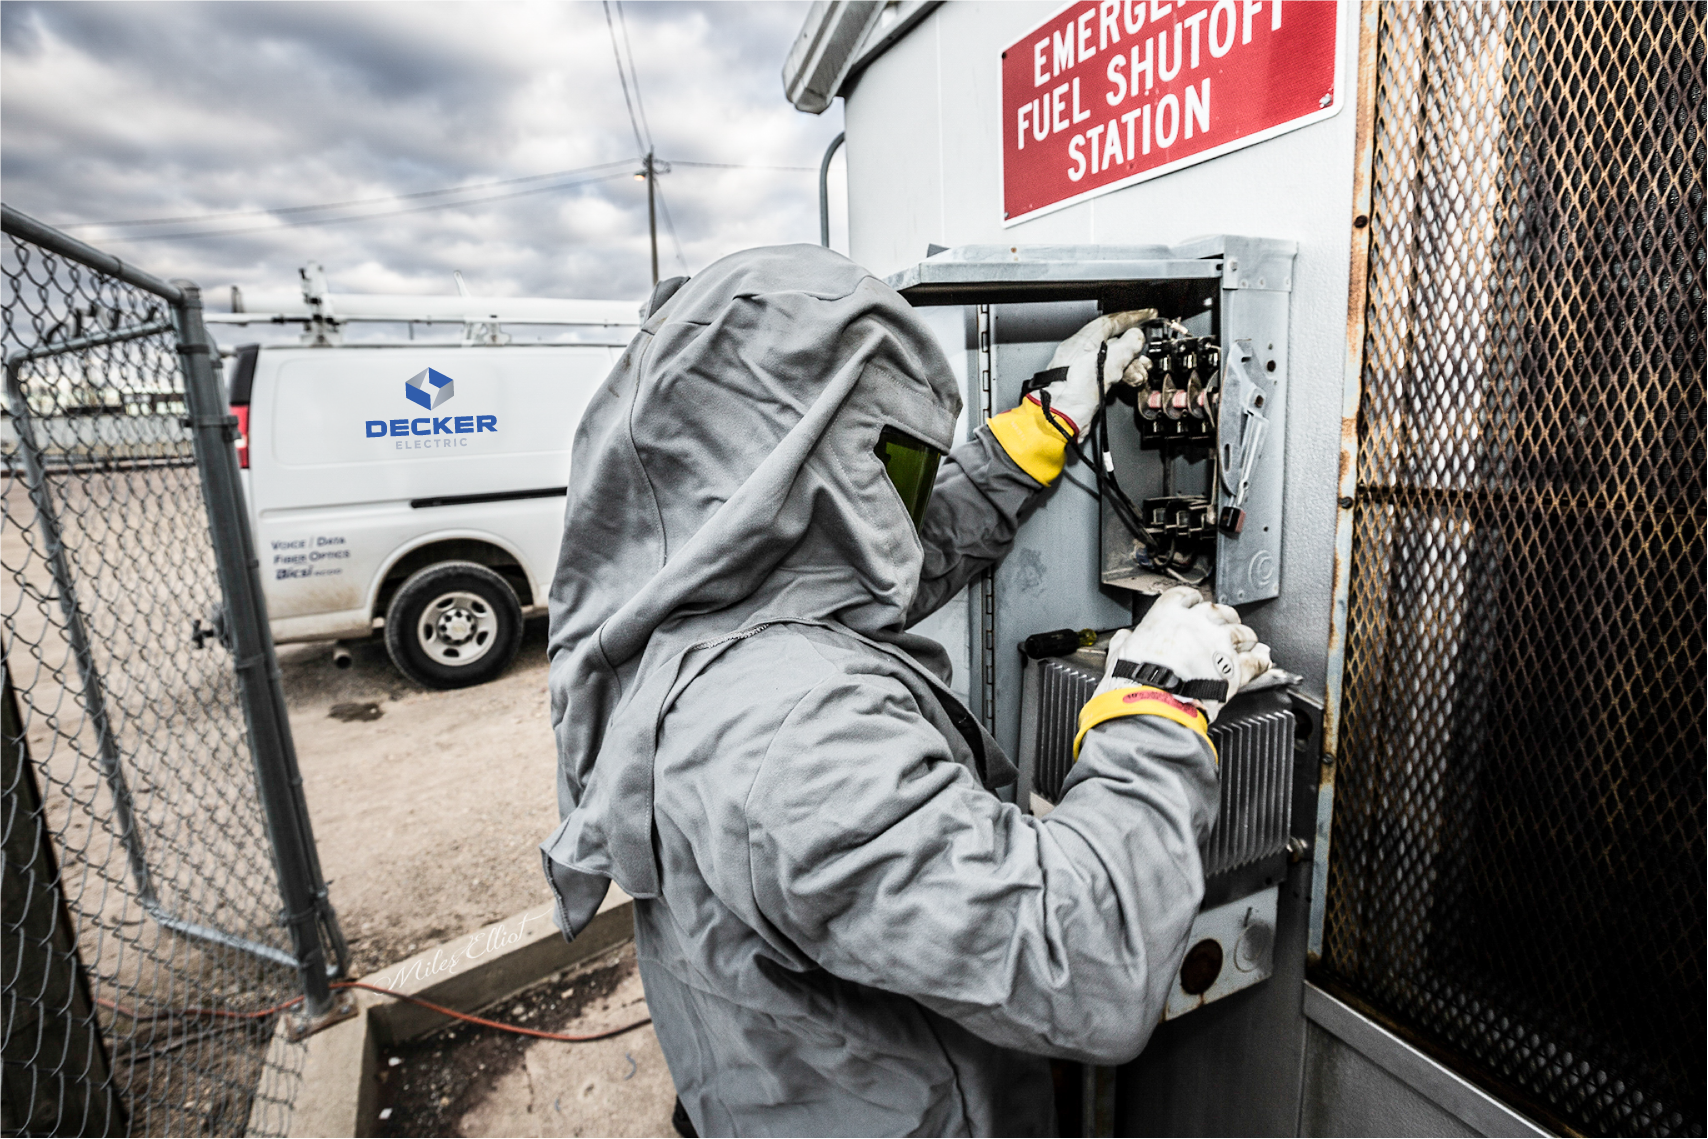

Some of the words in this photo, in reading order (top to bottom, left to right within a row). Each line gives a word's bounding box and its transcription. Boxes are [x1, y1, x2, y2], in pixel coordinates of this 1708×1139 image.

[1034, 0, 1187, 87] EMERG
[1017, 77, 1091, 150] FUEL
[1067, 78, 1211, 182] STATION
[365, 415, 498, 438] DECKER
[395, 437, 468, 450] ELECTRIC
[1217, 657, 1232, 674] 10
